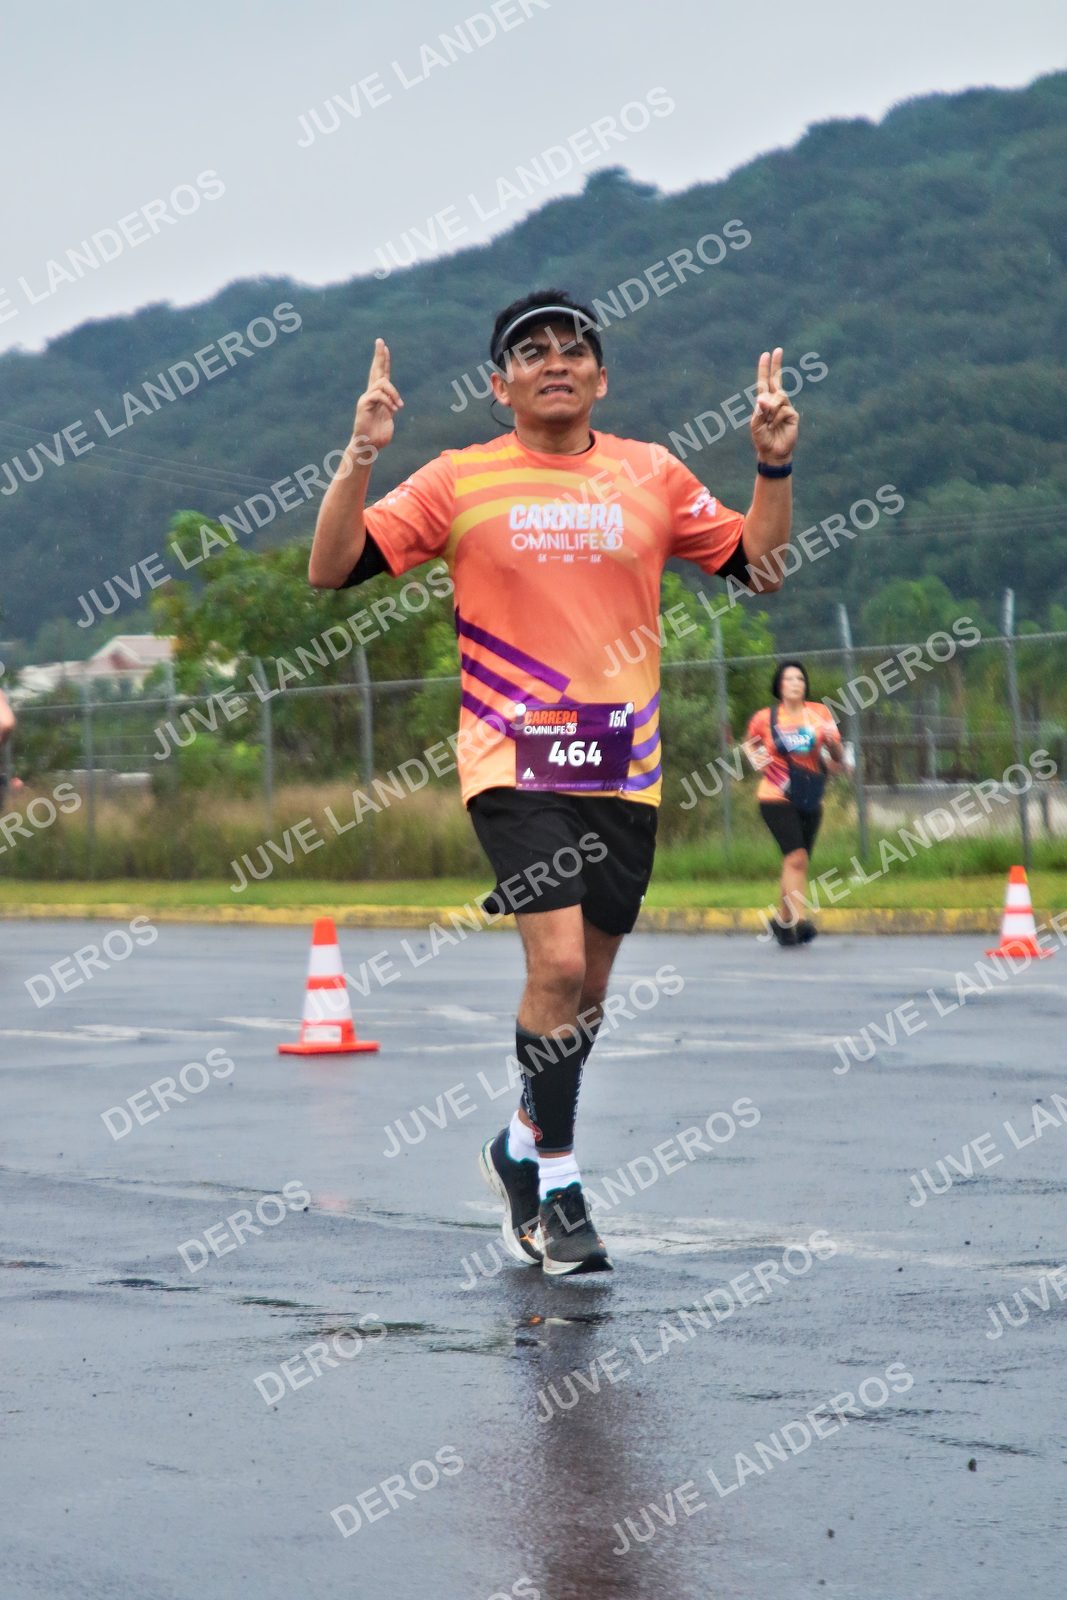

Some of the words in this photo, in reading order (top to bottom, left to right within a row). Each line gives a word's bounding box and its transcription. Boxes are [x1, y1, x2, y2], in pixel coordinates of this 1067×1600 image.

[510, 503, 623, 530] CARRERA
[511, 533, 600, 550] OMNILIFE
[525, 711, 577, 725] CARRERA
[609, 710, 628, 727] 15K
[524, 726, 565, 735] OMNILIFE
[548, 741, 602, 766] 464
